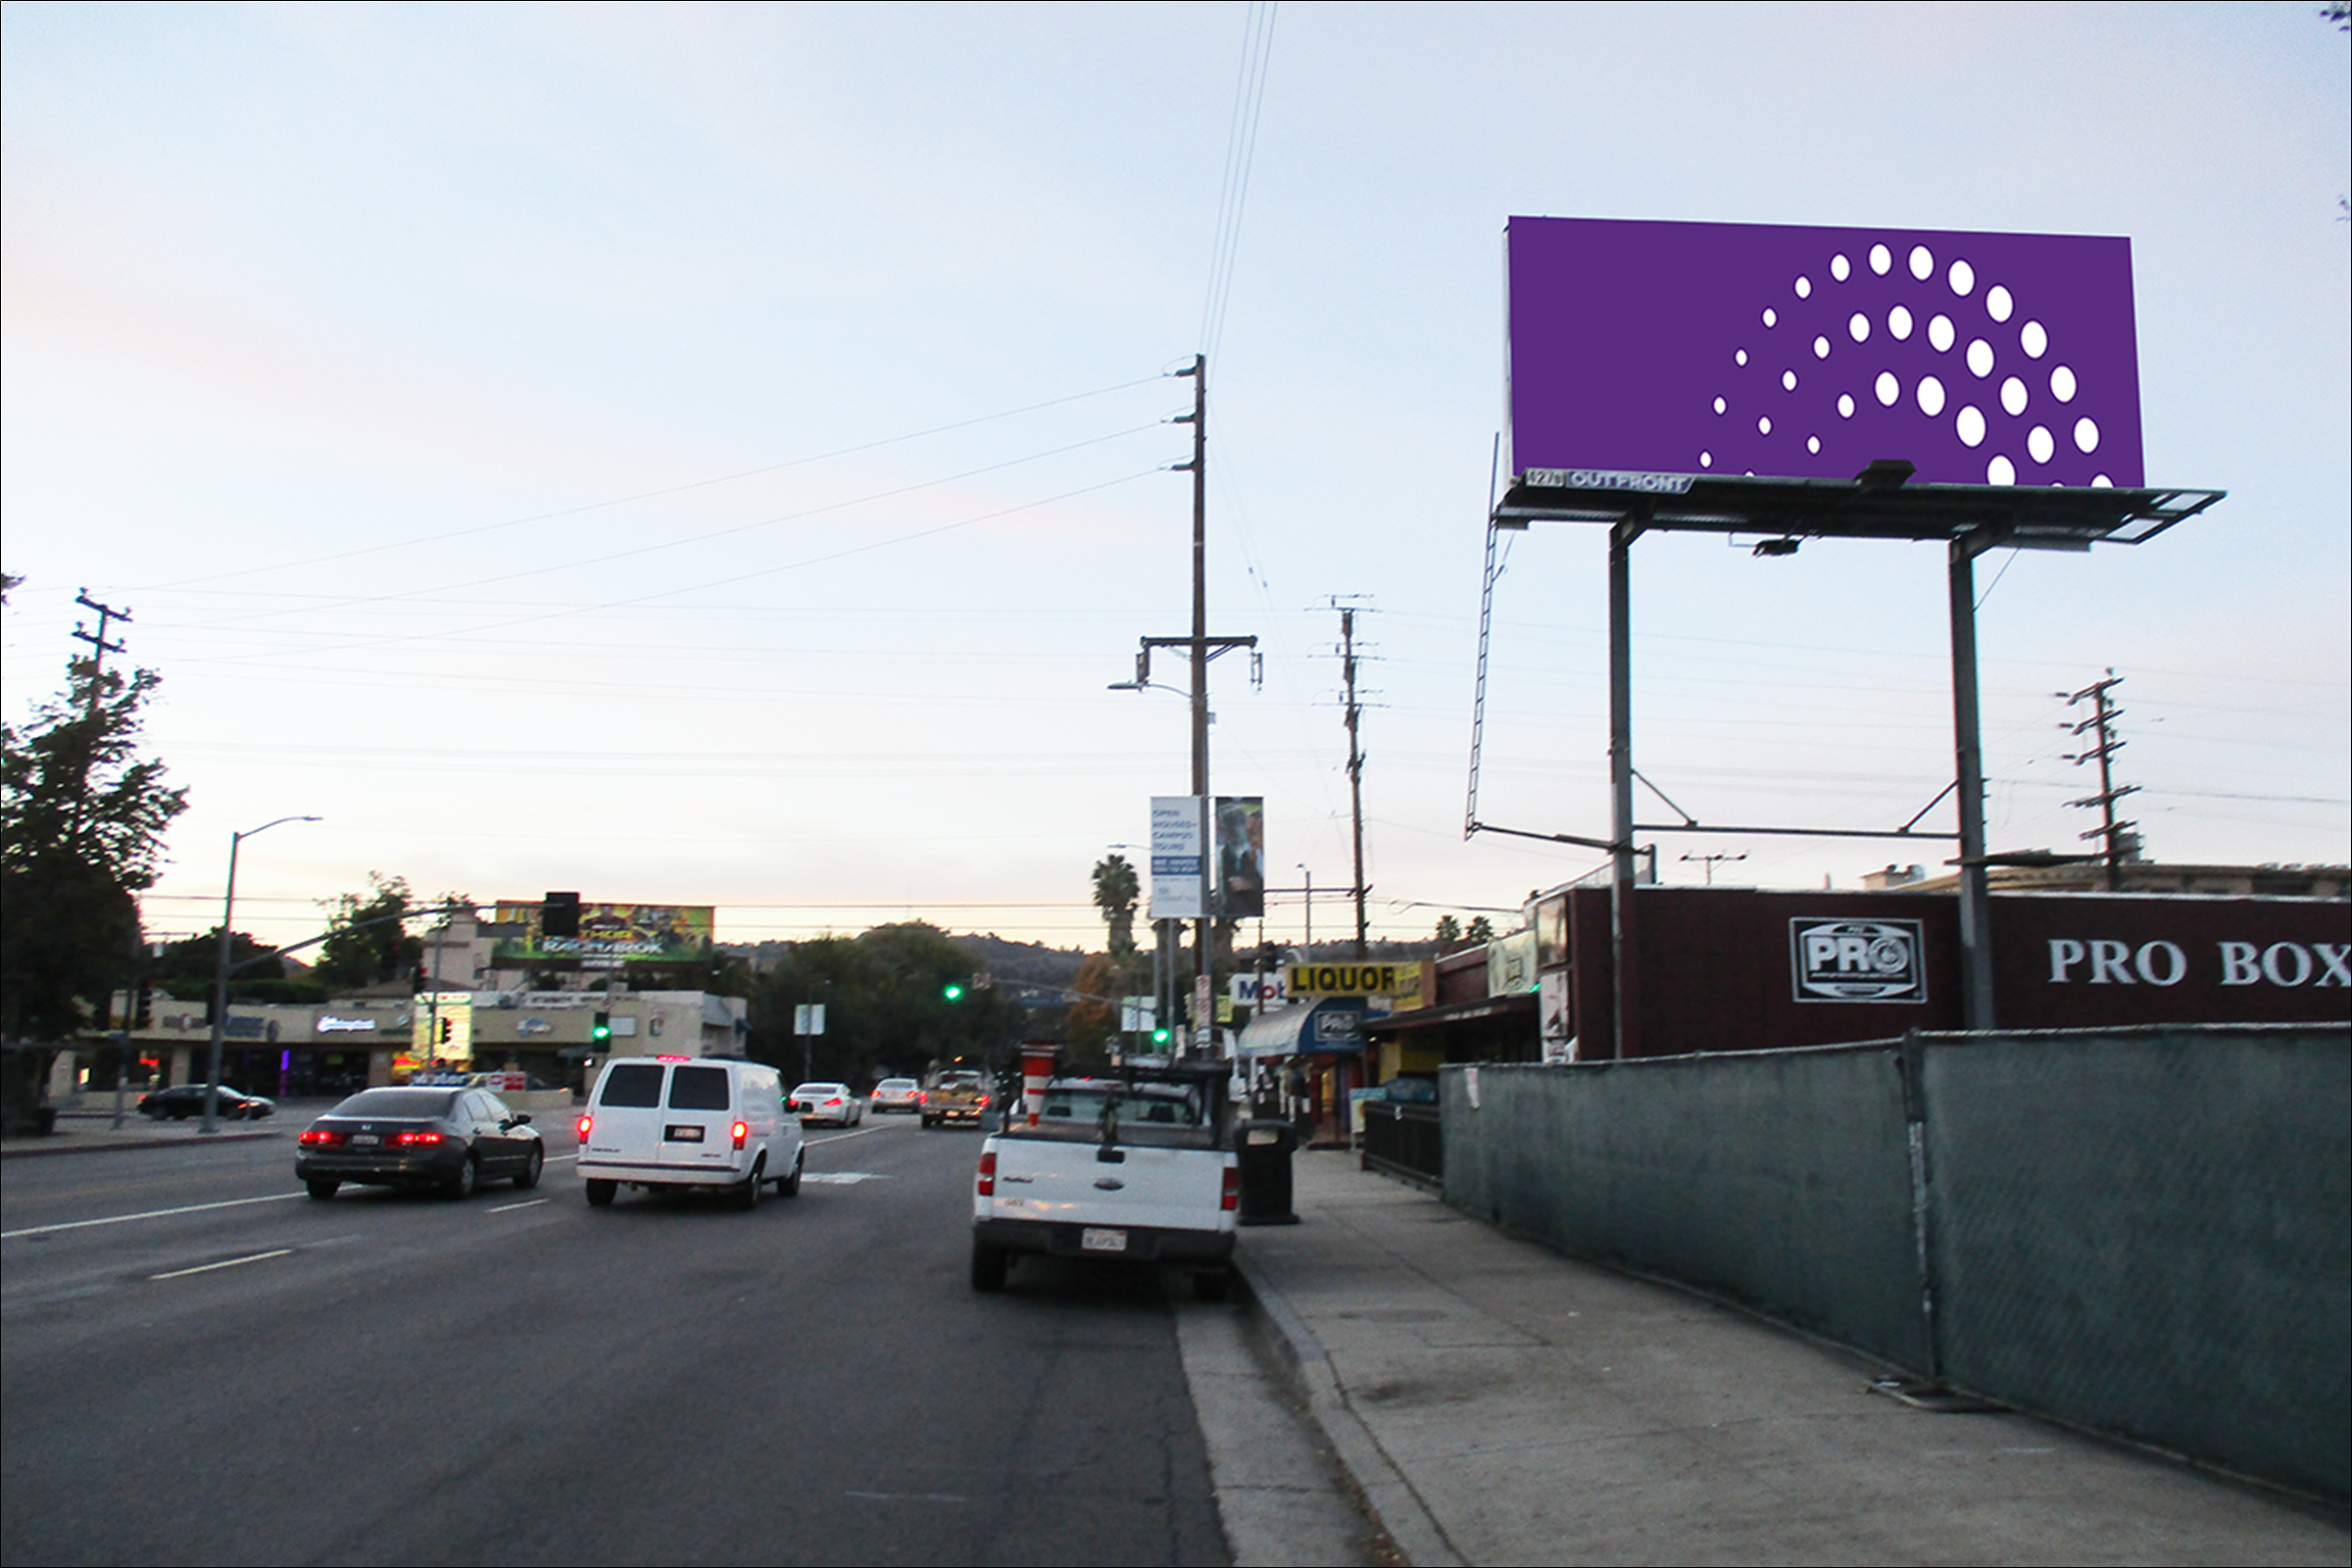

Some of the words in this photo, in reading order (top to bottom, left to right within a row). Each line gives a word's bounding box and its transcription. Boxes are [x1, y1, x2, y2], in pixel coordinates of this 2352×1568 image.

[1571, 472, 1690, 492] OUTFRONT
[1807, 936, 1910, 974] PRO
[2048, 938, 2187, 986] PRO
[2217, 941, 2351, 988] BOX
[1292, 966, 1395, 992] LIQUOR
